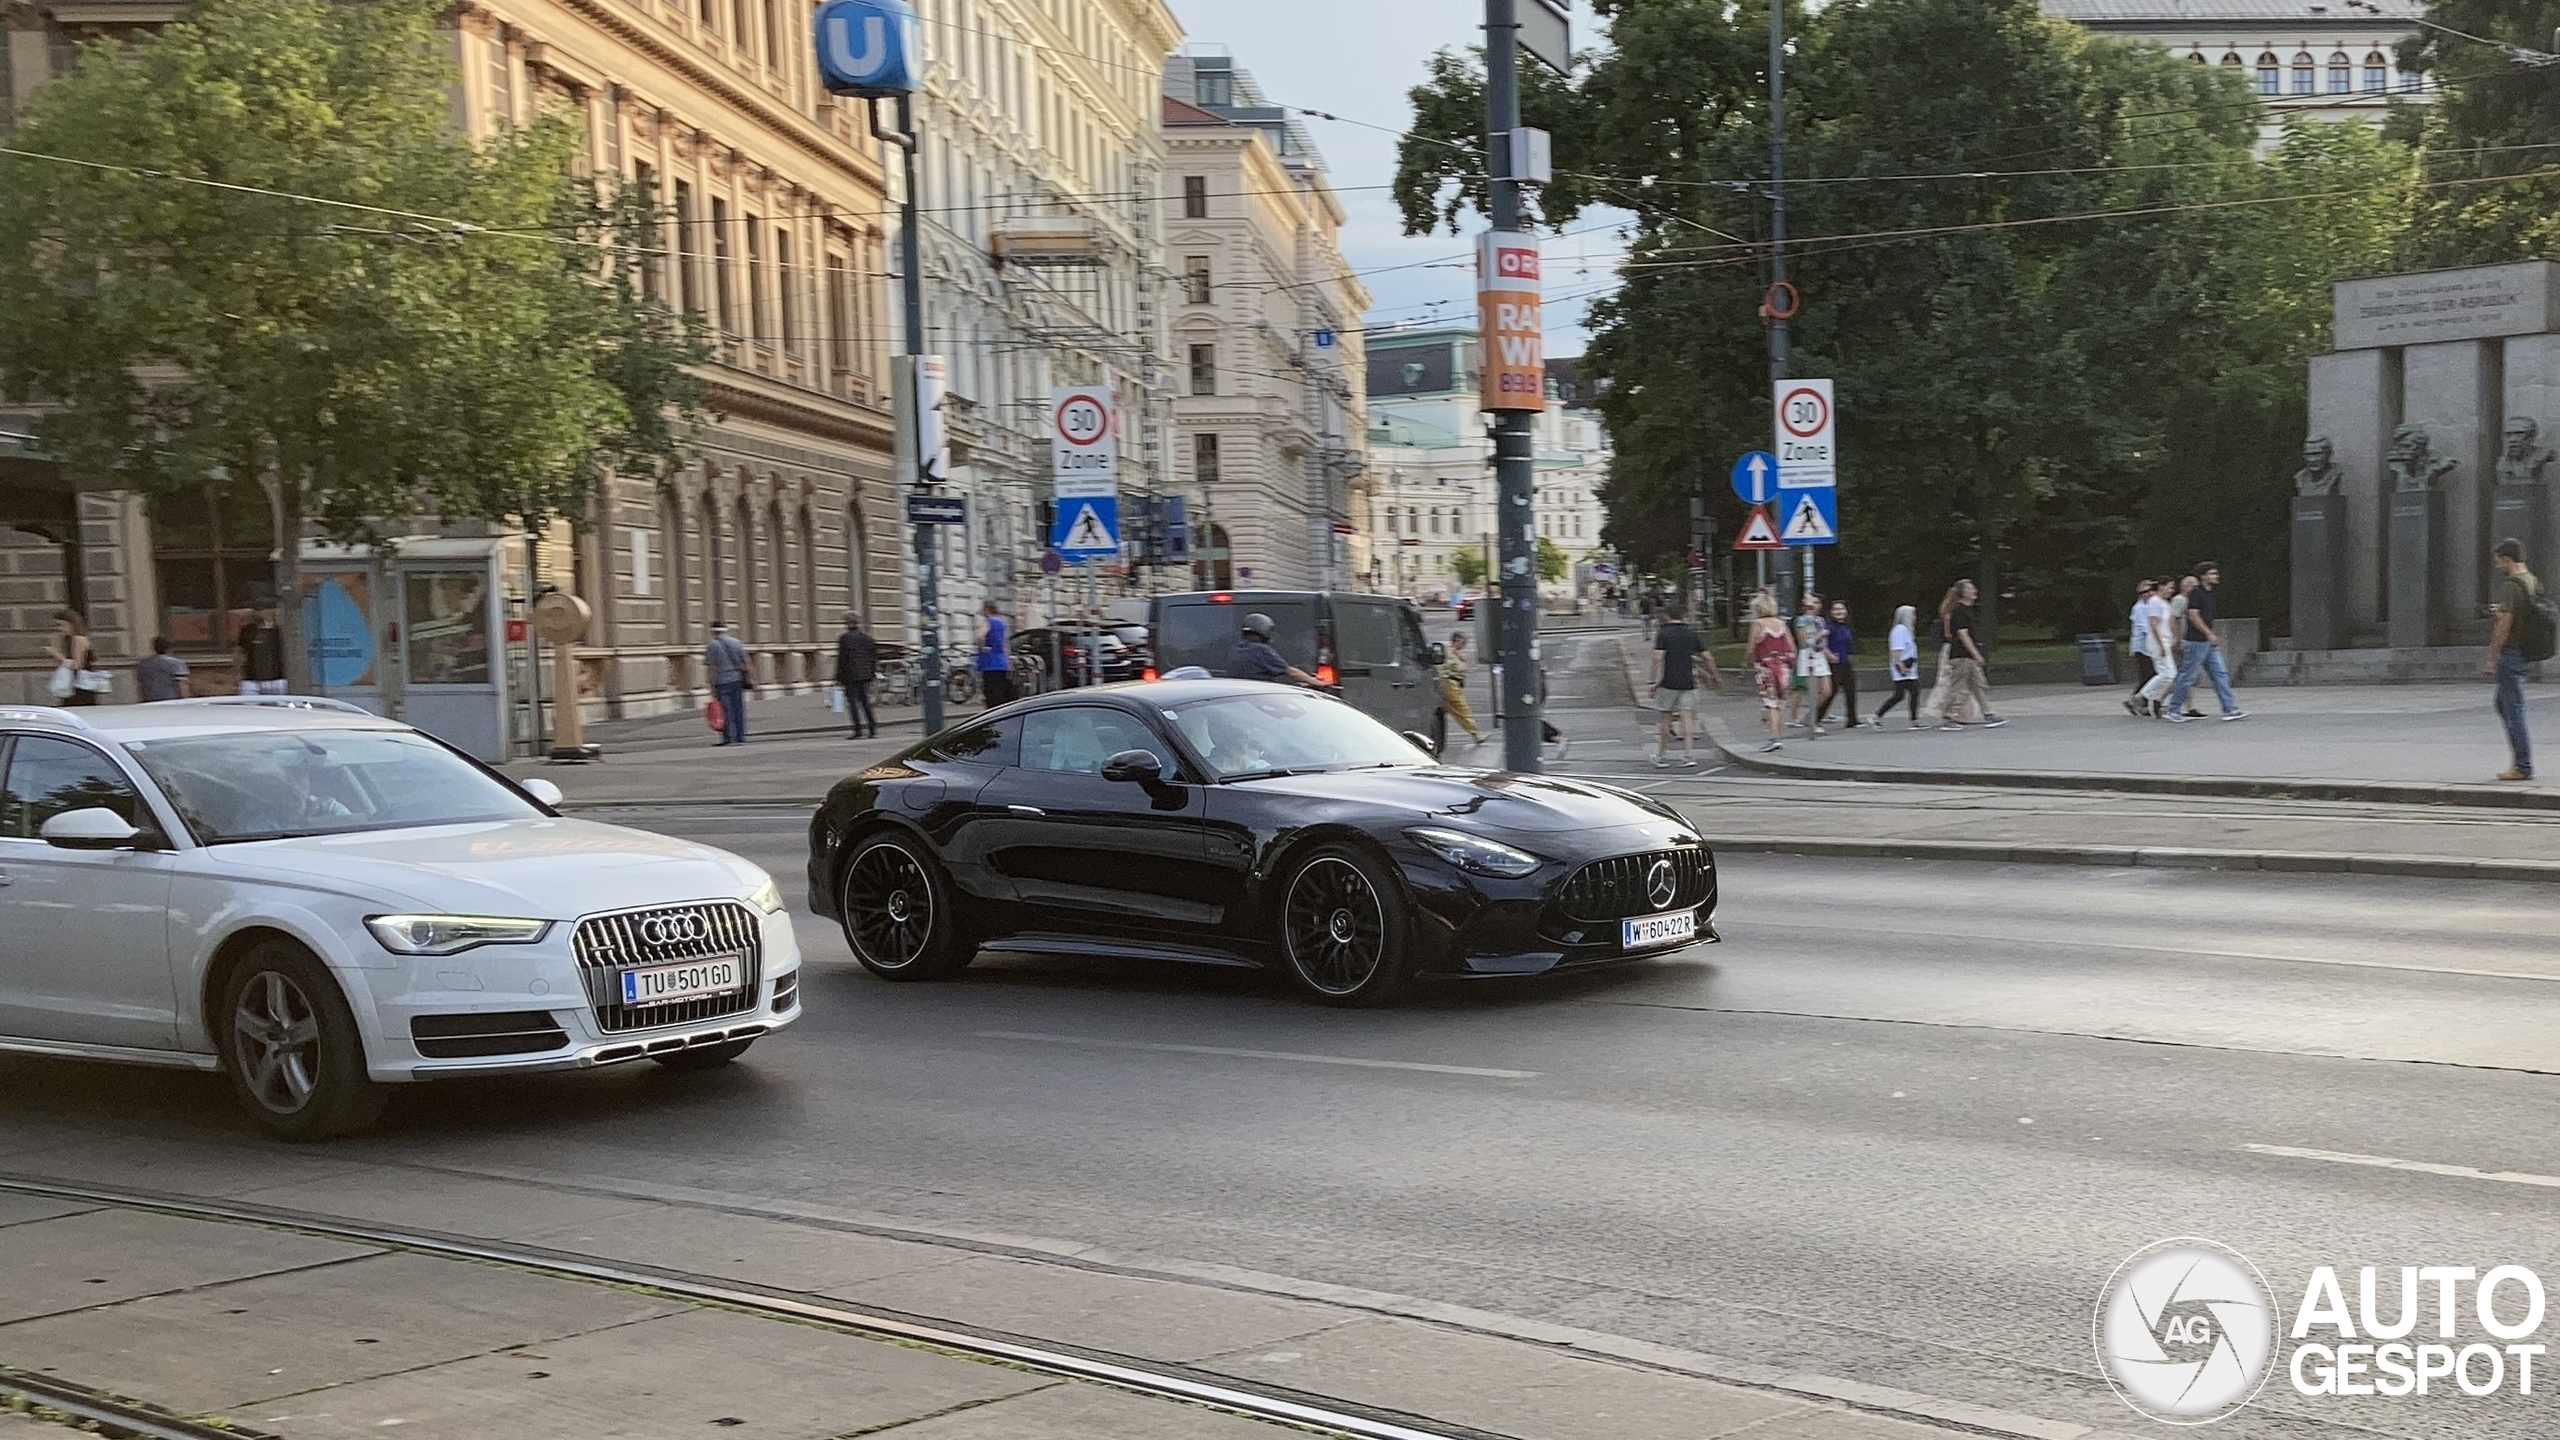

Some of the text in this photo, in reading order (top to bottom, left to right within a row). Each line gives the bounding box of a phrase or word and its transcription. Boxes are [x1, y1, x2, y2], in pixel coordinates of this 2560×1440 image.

[826, 16, 886, 77] U
[1068, 408, 1097, 432] 30
[1792, 401, 1818, 424] 30
[1059, 449, 1109, 470] Zone
[1783, 441, 1829, 461] Zone
[1633, 917, 1690, 941] W 60422R
[642, 973, 665, 995] TU
